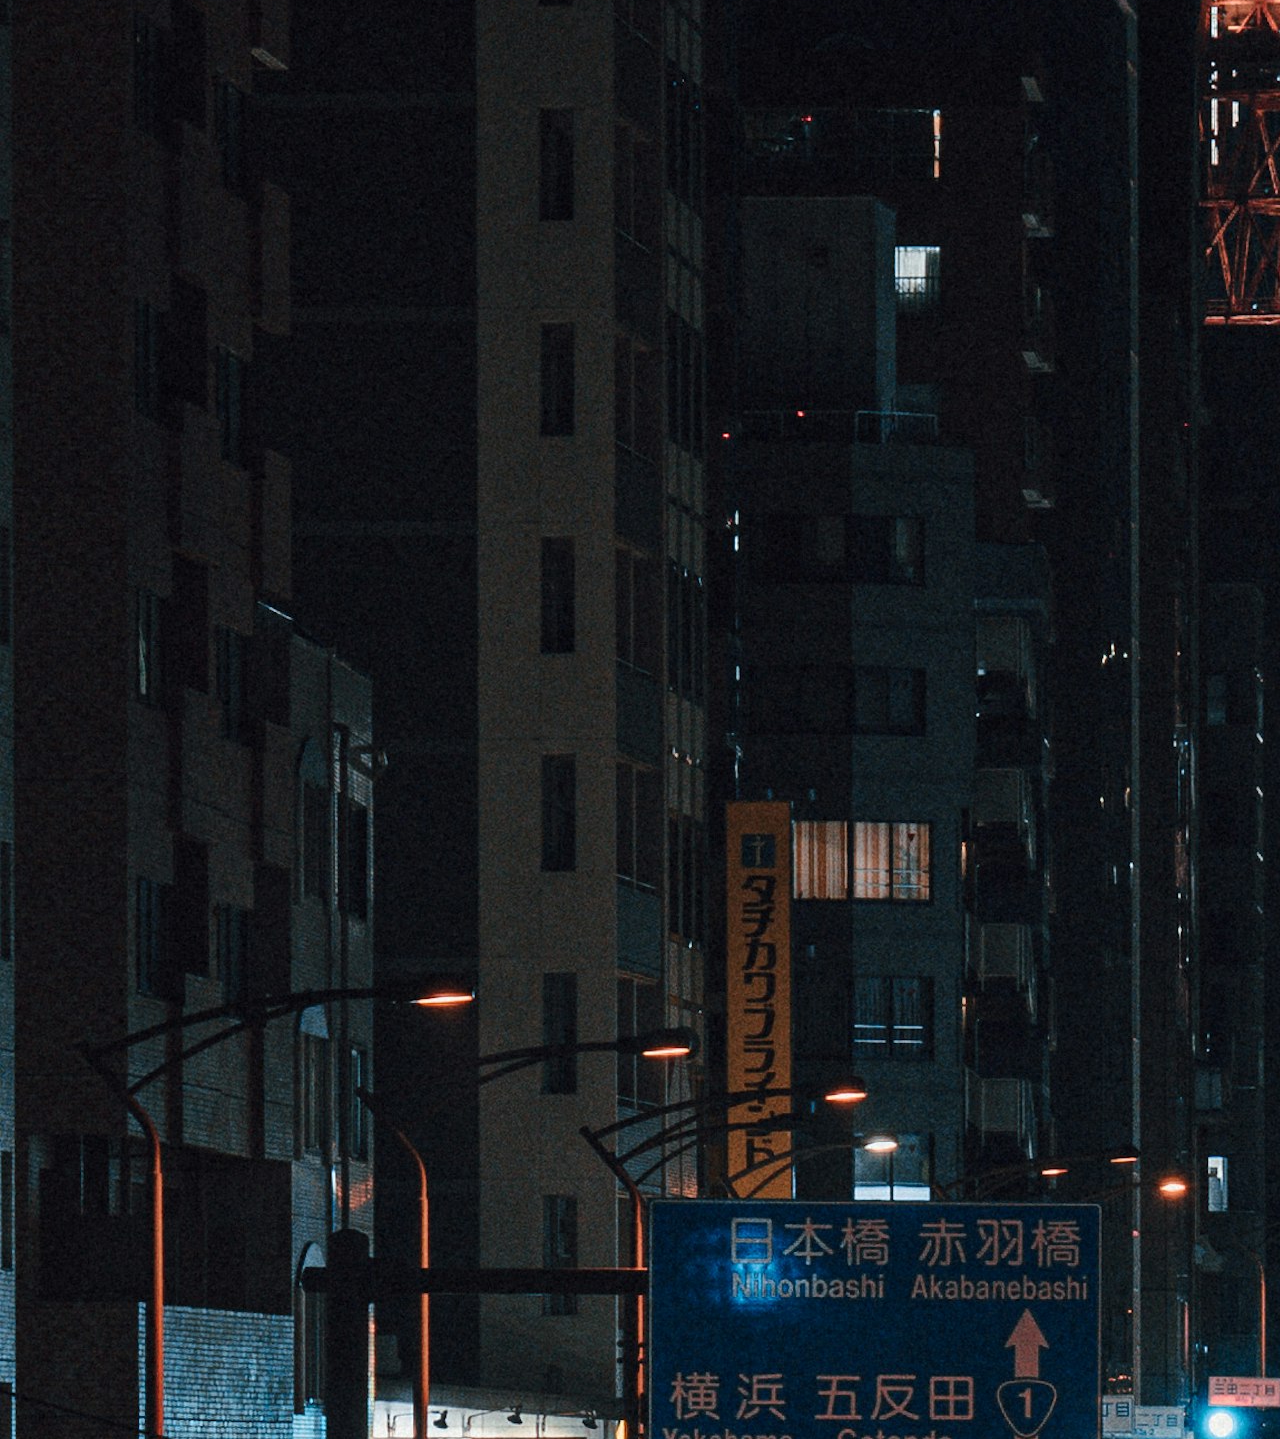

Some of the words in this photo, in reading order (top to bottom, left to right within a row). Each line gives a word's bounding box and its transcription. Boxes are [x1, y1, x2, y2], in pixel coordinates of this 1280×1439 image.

[731, 1217, 889, 1266] 日本橋
[918, 1218, 1083, 1267] 赤羽橋
[731, 1272, 885, 1300] Nihonbashi
[911, 1274, 1088, 1301] Akabanebashi
[670, 1373, 787, 1421] 横浜
[814, 1374, 975, 1421] 五反田
[1018, 1388, 1032, 1418] 1
